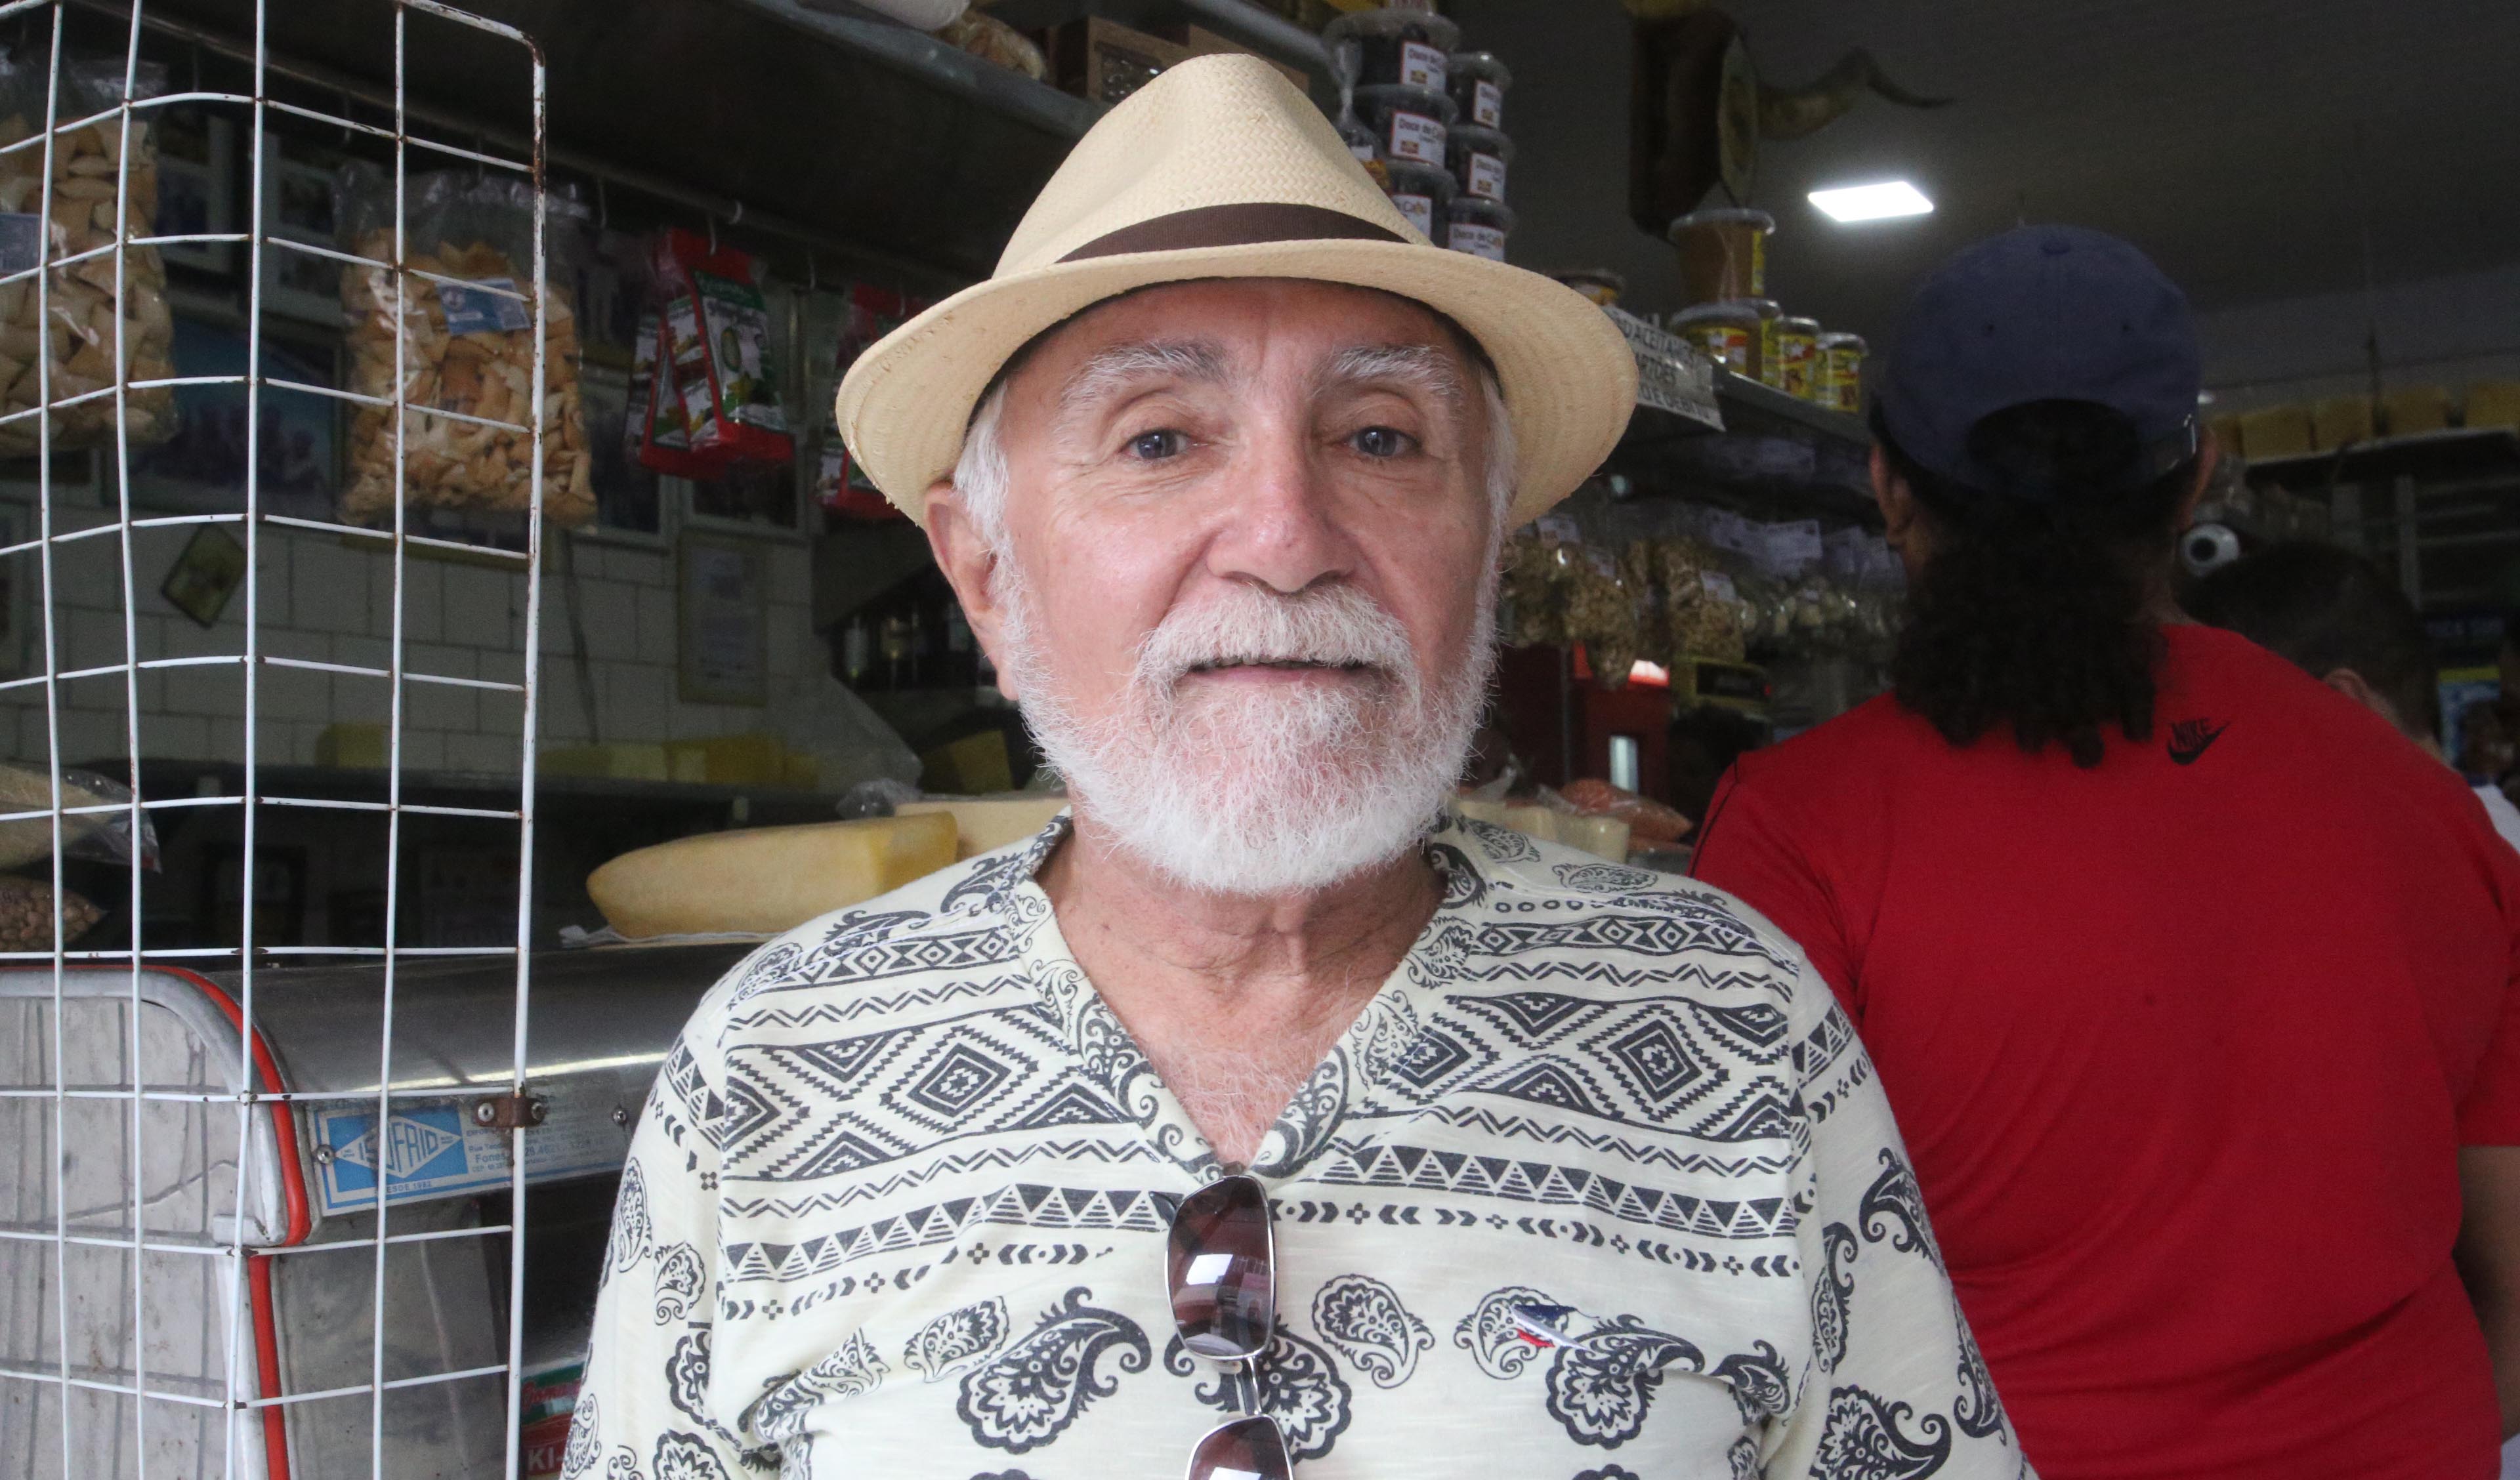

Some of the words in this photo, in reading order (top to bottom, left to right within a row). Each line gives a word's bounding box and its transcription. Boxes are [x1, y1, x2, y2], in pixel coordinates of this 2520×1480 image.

[1398, 117, 1419, 131] Doce
[2172, 718, 2210, 748] NIKE
[379, 1182, 410, 1193] ESDE
